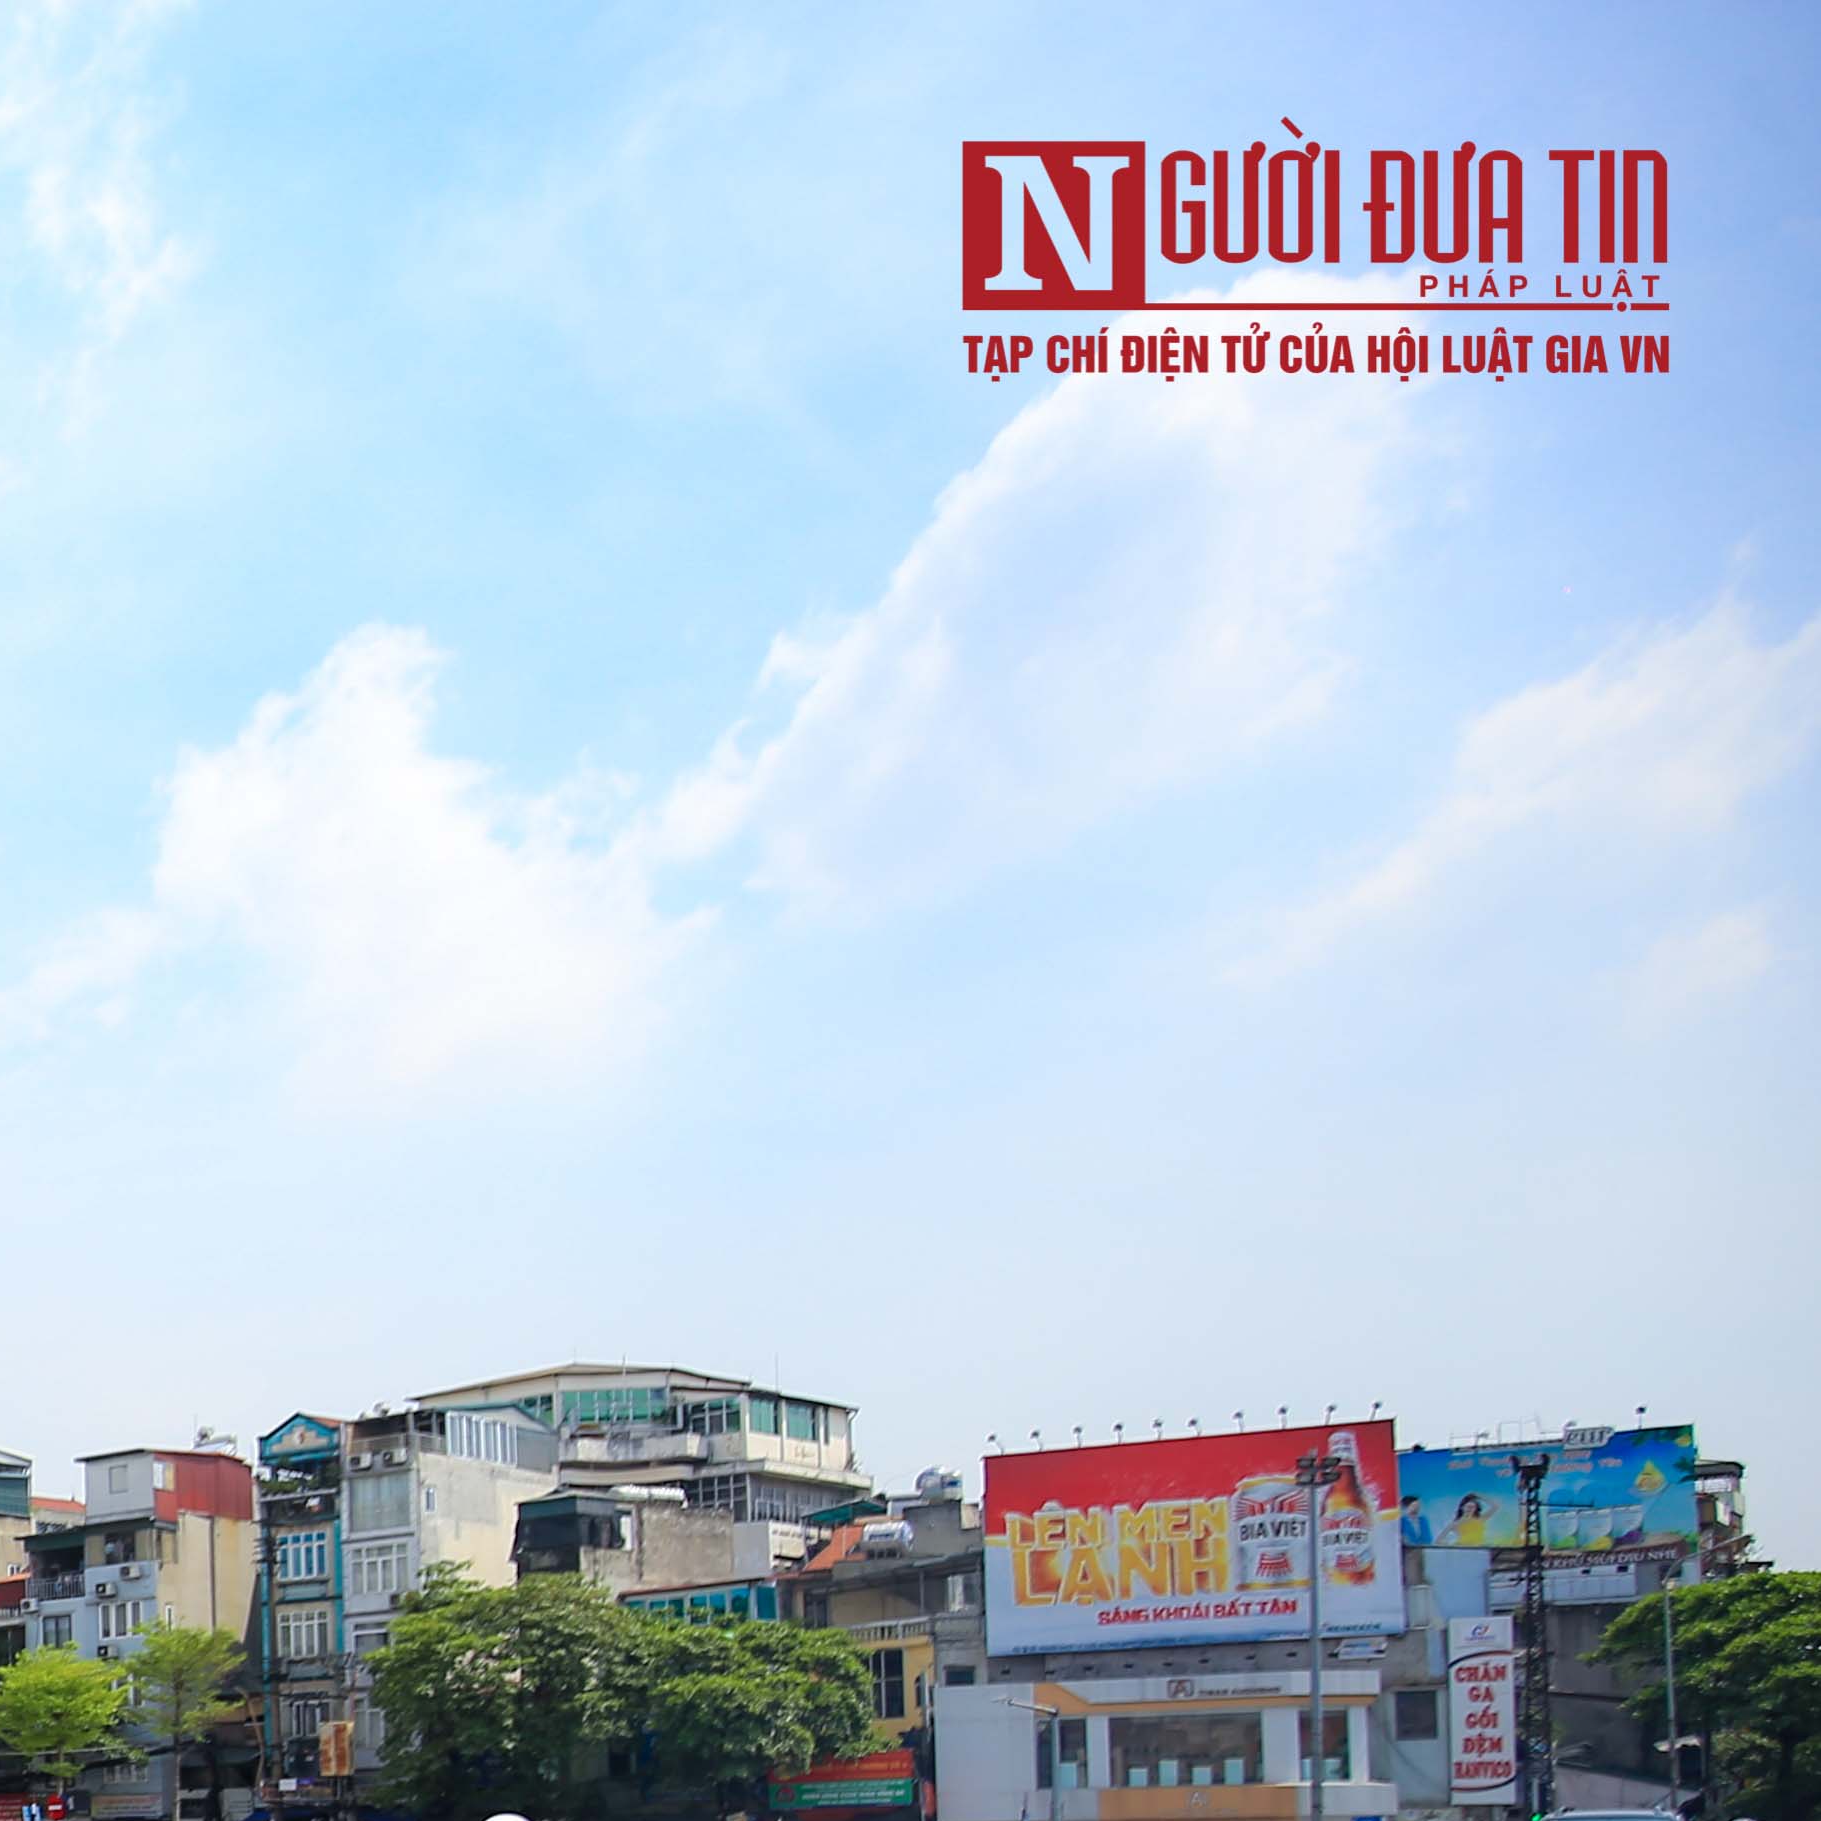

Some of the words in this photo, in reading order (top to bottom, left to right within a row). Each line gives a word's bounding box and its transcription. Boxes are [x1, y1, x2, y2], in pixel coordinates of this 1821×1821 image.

[1006, 1499, 1100, 1550] LÊN
[1115, 1496, 1229, 1547] MEN
[1240, 1519, 1272, 1543] BIA
[1013, 1535, 1230, 1608] LẠNH
[1453, 1661, 1507, 1683] CHĂN
[1468, 1686, 1494, 1703] GA
[1465, 1704, 1498, 1729] GỐI
[1462, 1733, 1503, 1758] ĐỆM
